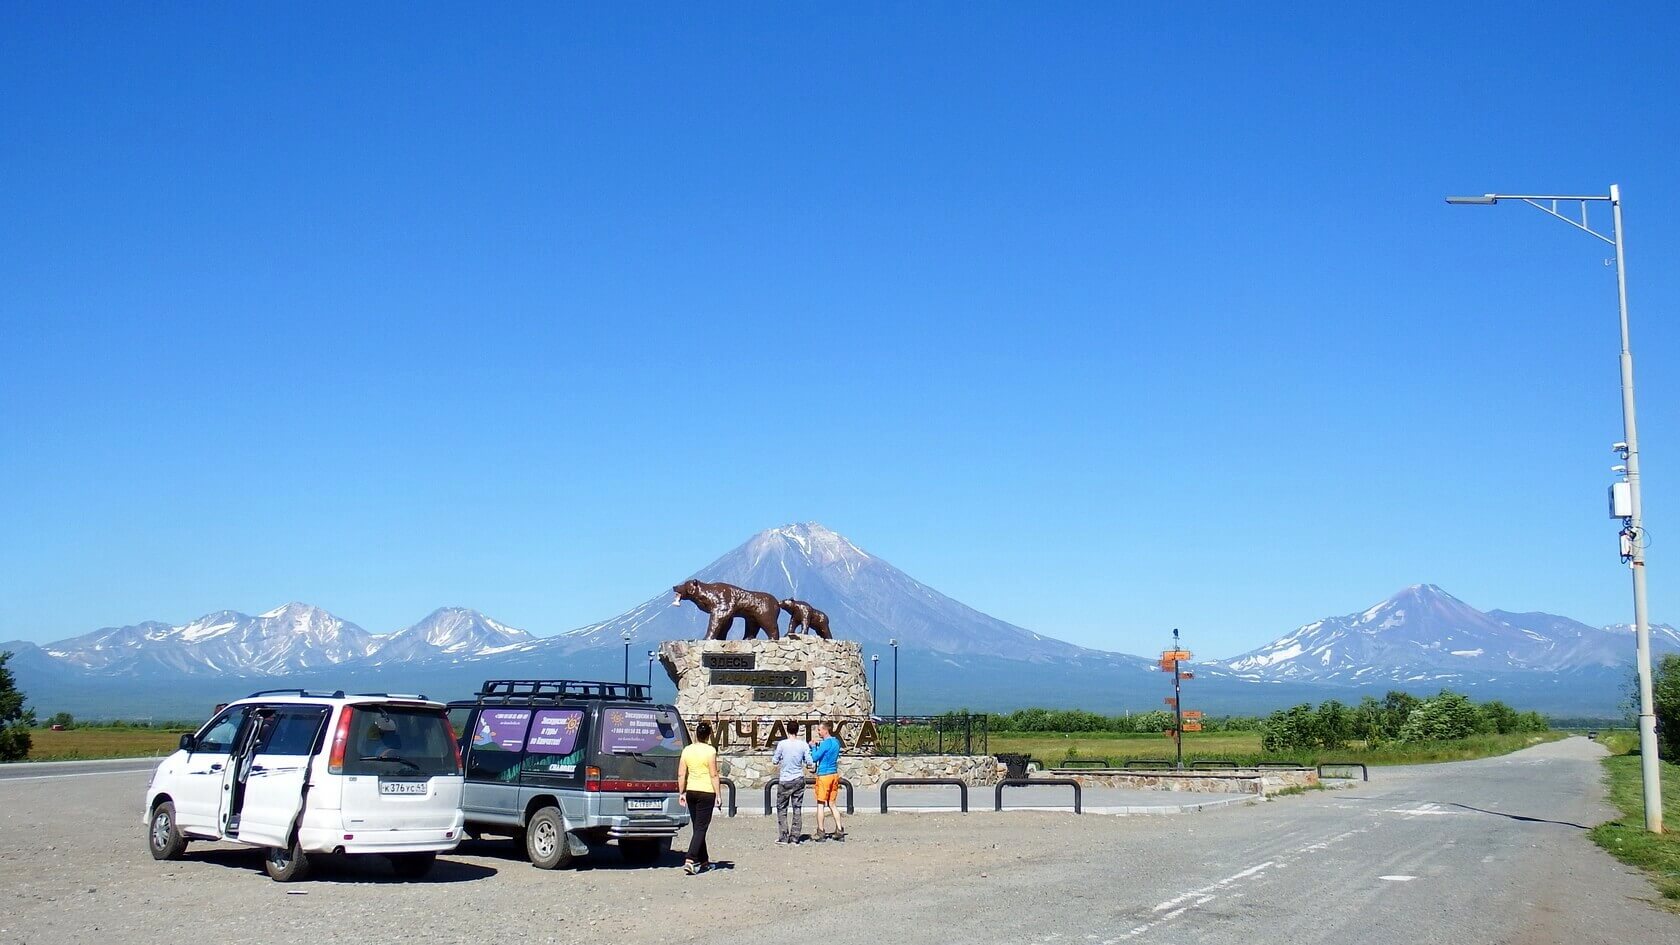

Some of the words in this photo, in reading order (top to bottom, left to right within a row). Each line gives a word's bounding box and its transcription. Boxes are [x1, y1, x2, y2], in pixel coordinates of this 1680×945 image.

[710, 657, 748, 668] ЗДЕСЬ
[760, 690, 810, 702] РОССИЯ
[684, 719, 878, 750] МЧАТКА
